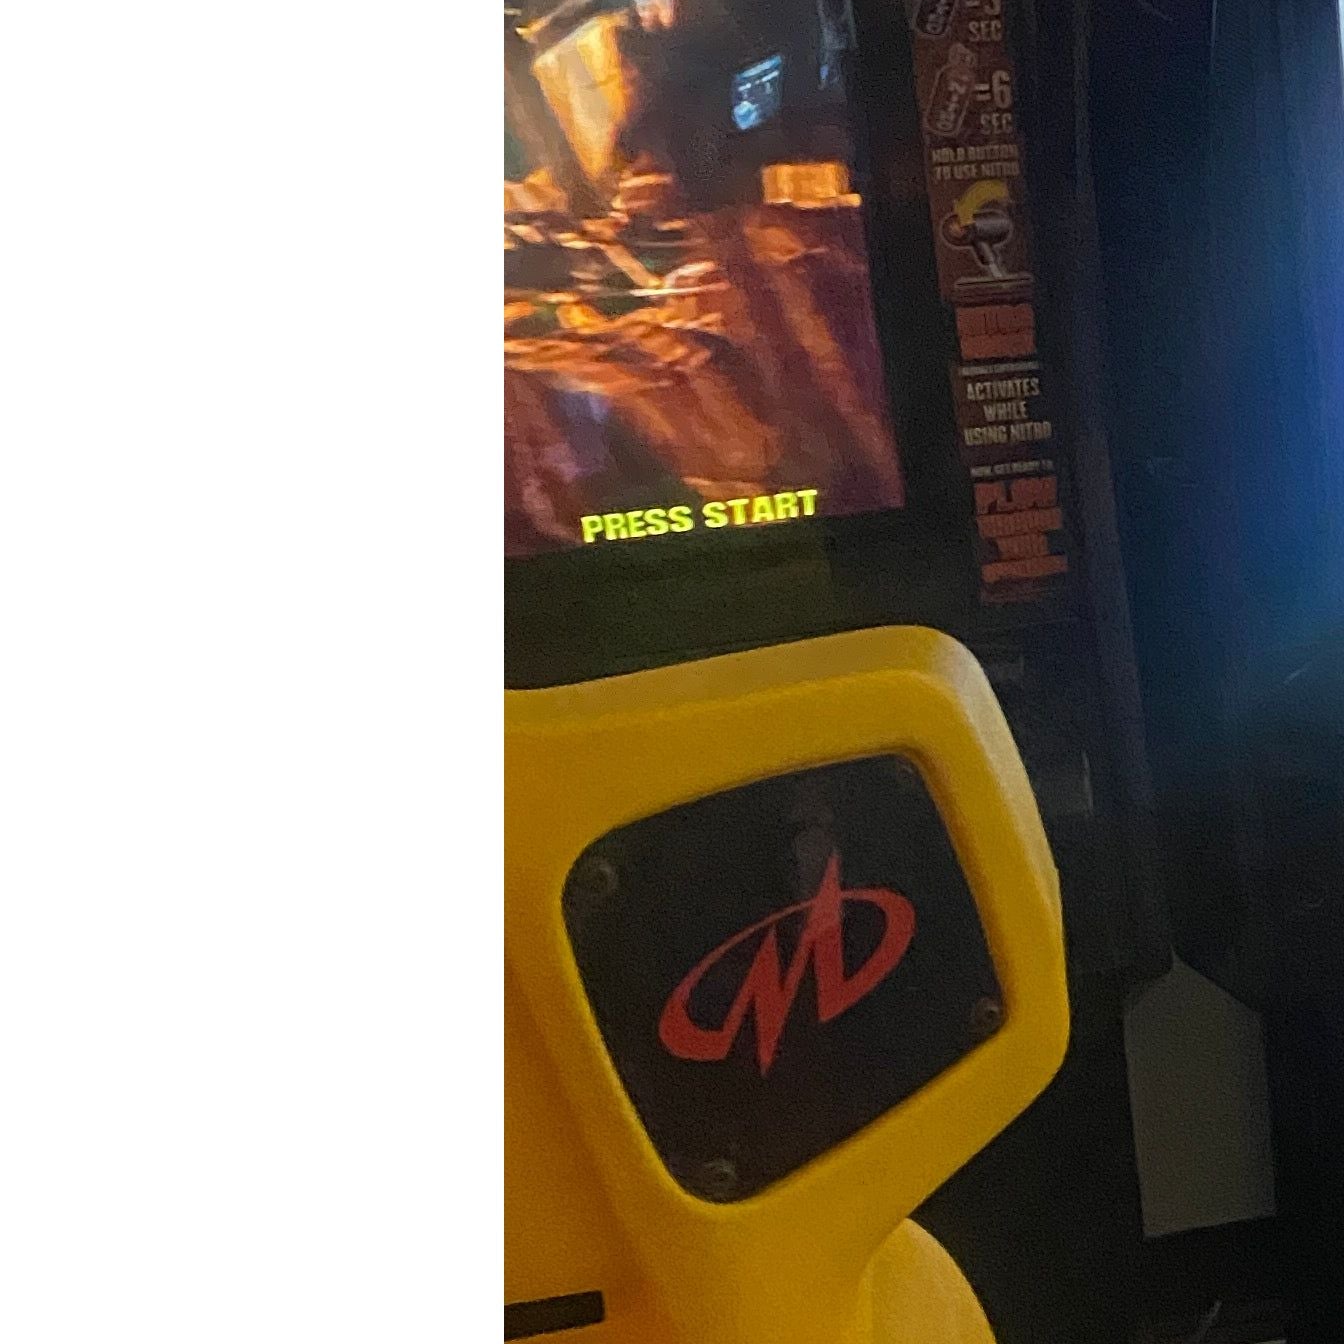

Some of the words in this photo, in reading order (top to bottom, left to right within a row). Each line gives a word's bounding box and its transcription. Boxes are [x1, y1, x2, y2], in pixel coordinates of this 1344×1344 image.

[966, 377, 1041, 401] ACTIVATES
[983, 400, 1028, 422] WHILE
[963, 424, 1007, 446] USING
[1009, 420, 1053, 444] NITRO
[580, 505, 696, 544] PRESS
[701, 488, 819, 529] START
